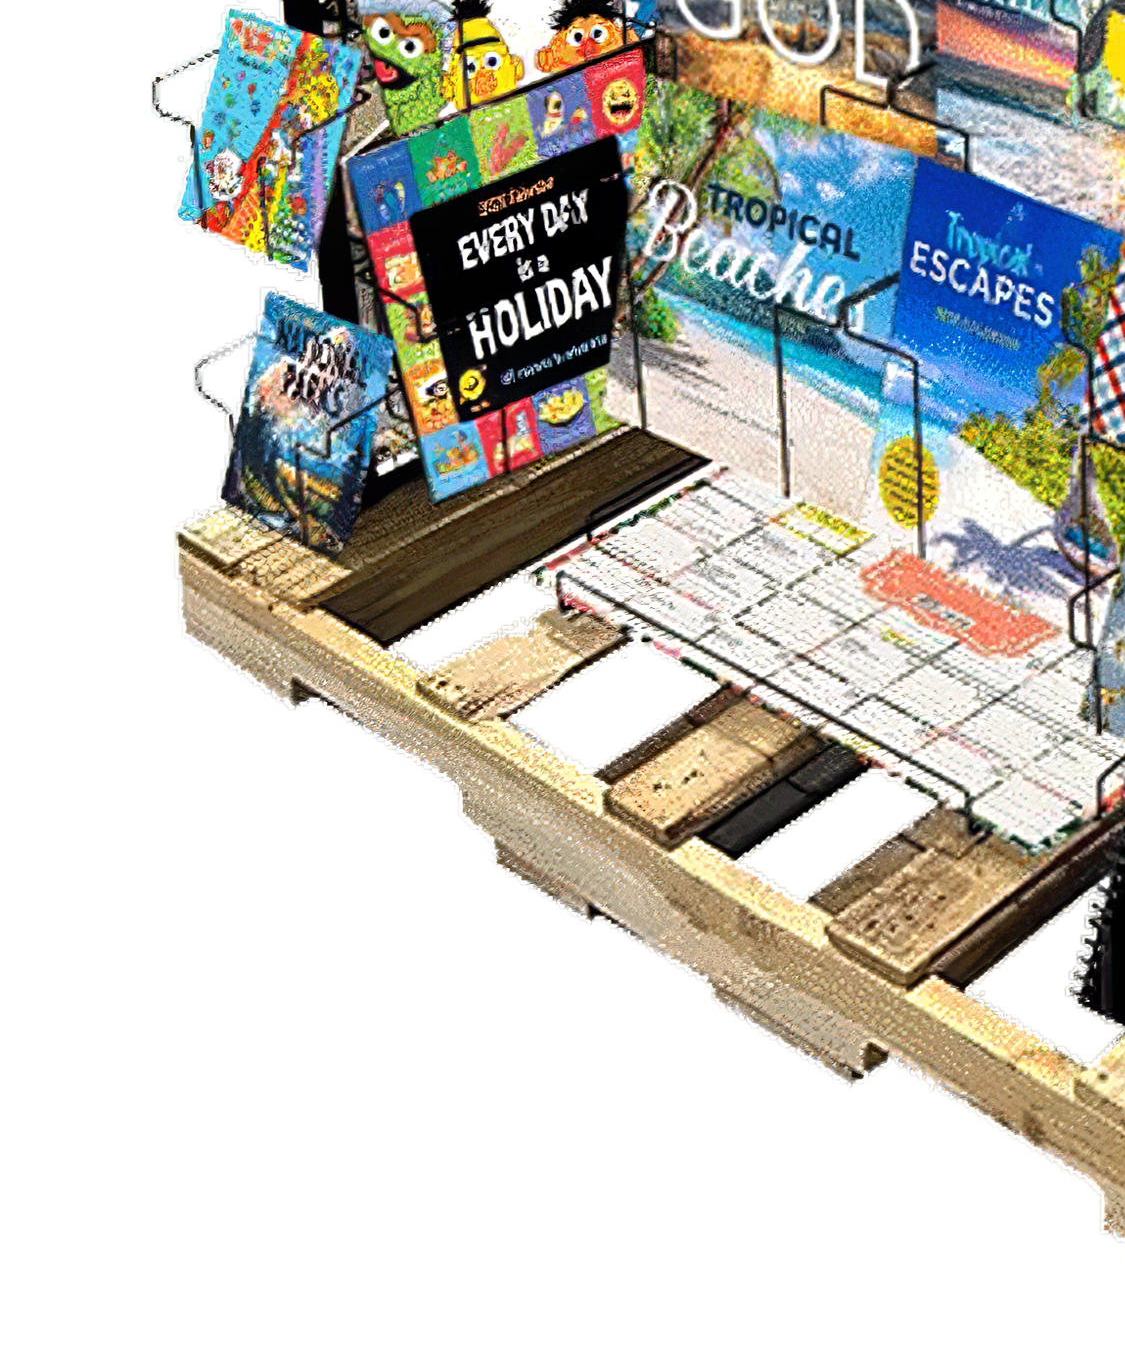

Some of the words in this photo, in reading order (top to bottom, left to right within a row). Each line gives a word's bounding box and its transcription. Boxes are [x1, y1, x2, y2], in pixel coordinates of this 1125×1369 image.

[456, 204, 537, 271] EVERY
[541, 188, 590, 234] DAY
[707, 183, 861, 263] TROPICAL
[468, 255, 615, 361] HOLIDAY
[909, 241, 1056, 330] ESCAPES
